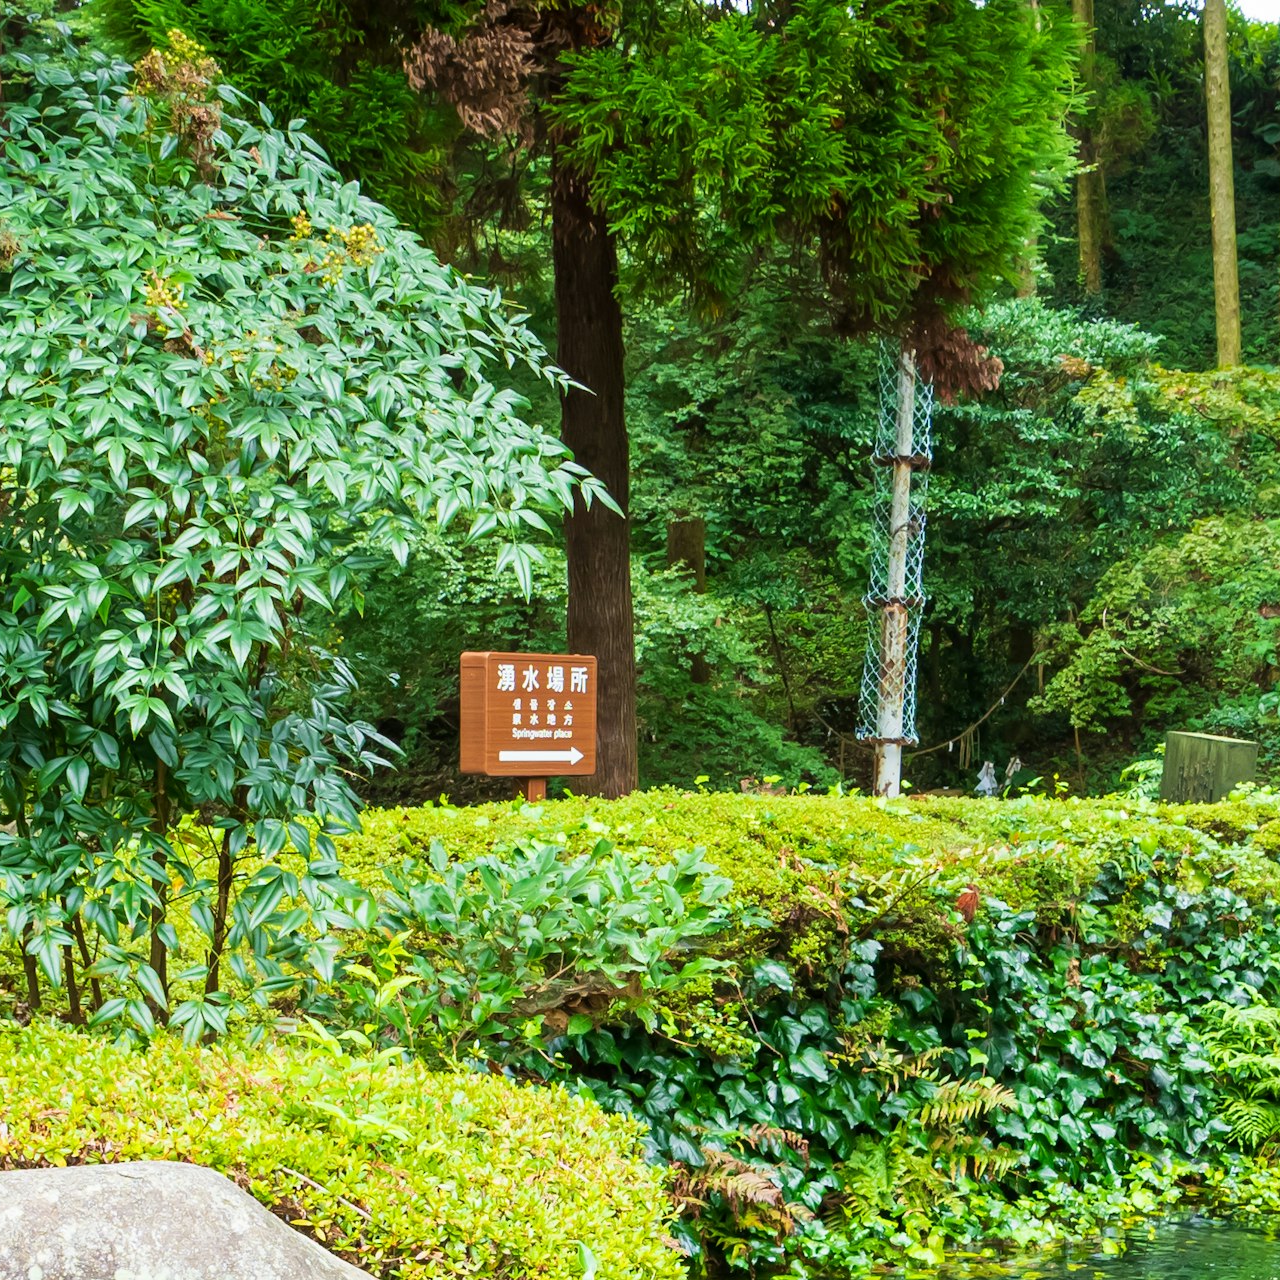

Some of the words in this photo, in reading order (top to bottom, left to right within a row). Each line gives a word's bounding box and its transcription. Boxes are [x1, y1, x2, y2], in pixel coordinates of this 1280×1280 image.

[497, 664, 588, 693] 湧水場所
[512, 727, 552, 740] Springwater
[553, 728, 573, 740] place
